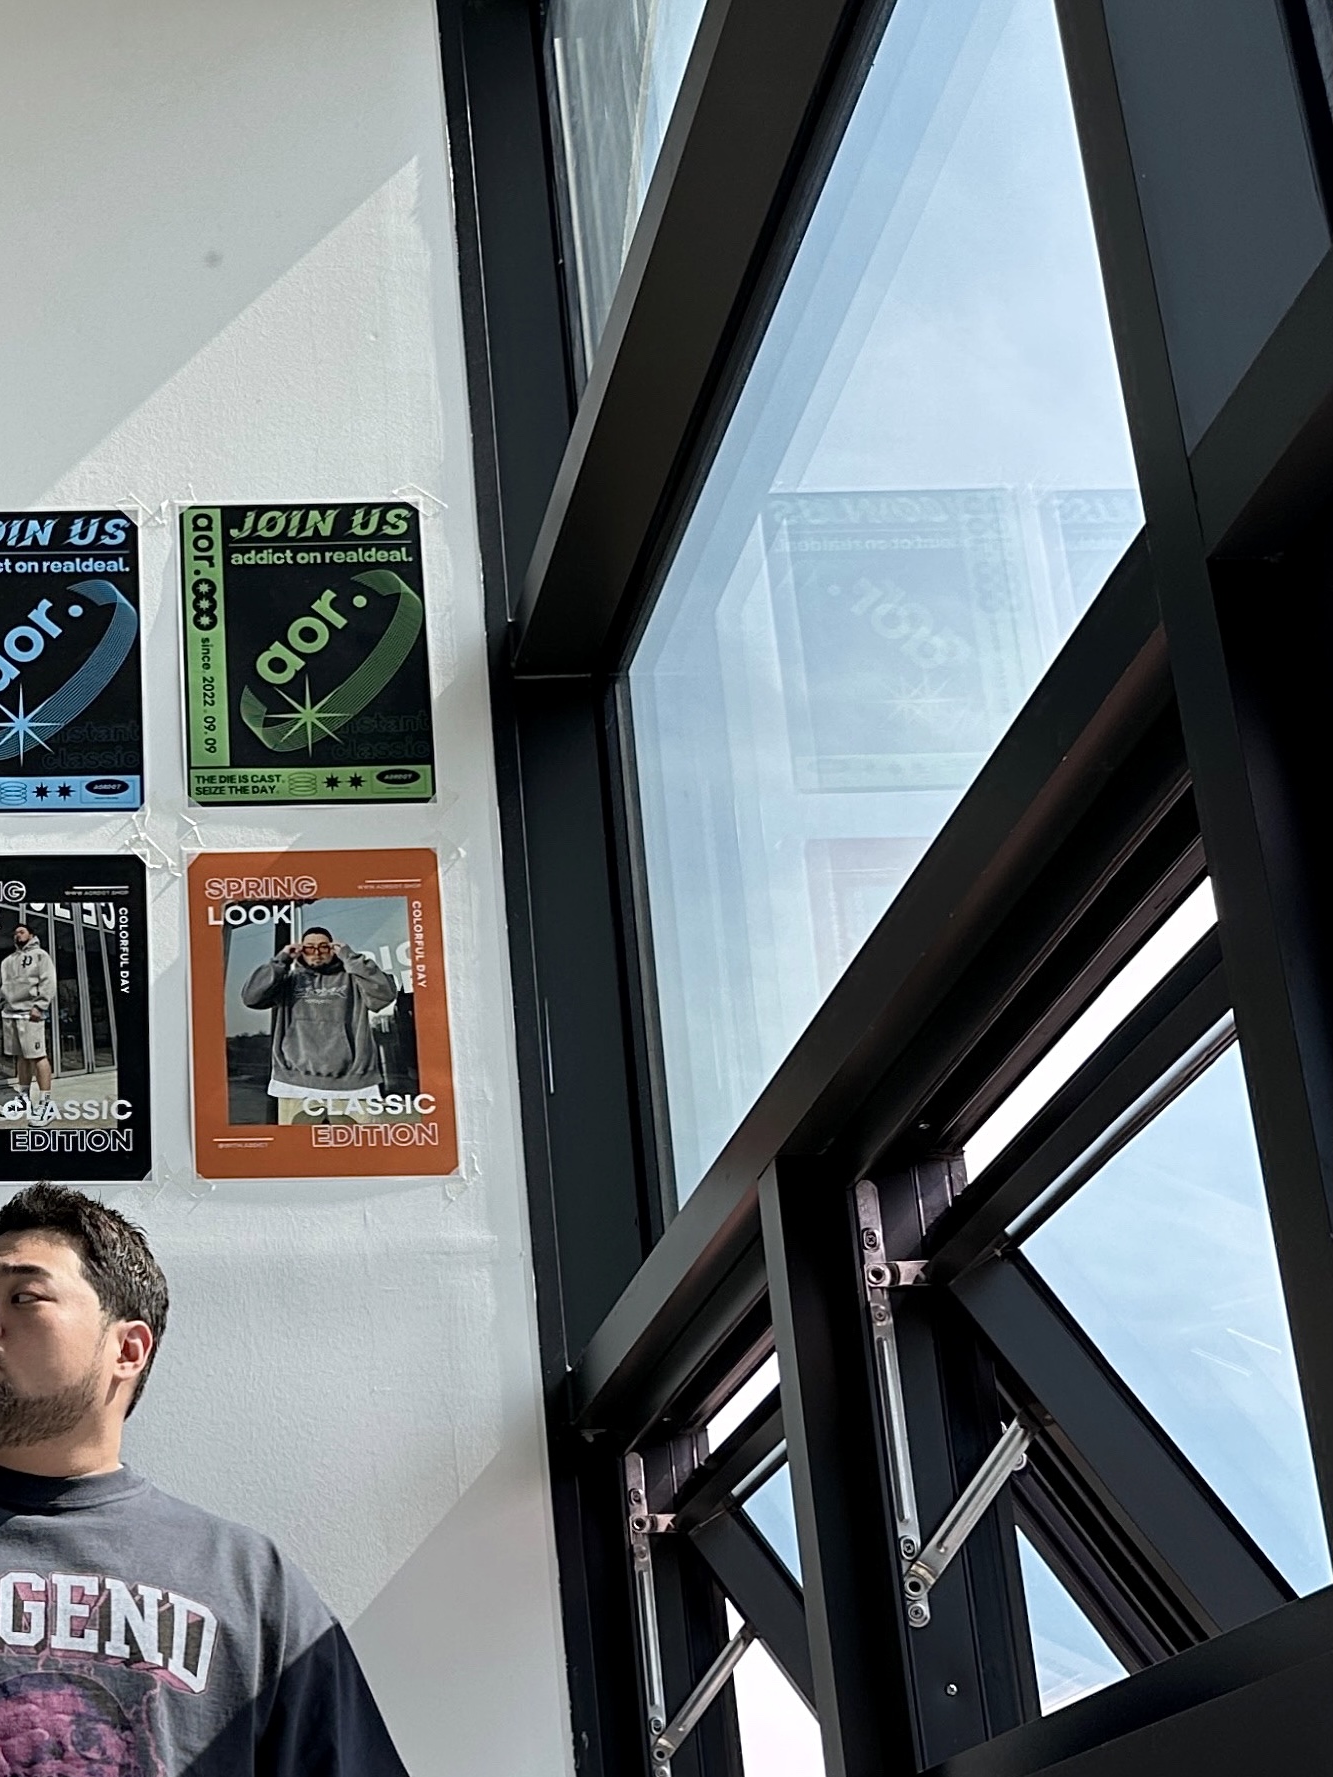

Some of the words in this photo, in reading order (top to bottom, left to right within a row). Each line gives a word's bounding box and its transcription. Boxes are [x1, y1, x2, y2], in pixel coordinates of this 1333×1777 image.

[62, 517, 130, 546] US
[229, 508, 341, 540] JOIN
[343, 507, 413, 537] US
[191, 513, 214, 577] aor.
[230, 549, 293, 565] addict
[296, 551, 321, 564] on
[324, 547, 413, 563] realdeal.
[14, 561, 40, 573] on
[42, 557, 129, 573] realdeal.
[256, 588, 367, 685] aor.
[205, 737, 217, 754] 09
[194, 775, 217, 784] THE
[219, 775, 237, 783] DIE
[238, 774, 249, 783] IS
[195, 786, 226, 795] SEIZE
[228, 786, 250, 794] THE
[205, 875, 318, 900] SPRING
[208, 904, 293, 926] LOOK
[118, 906, 129, 966] COLORFUL
[412, 901, 425, 962] COLORFUL
[119, 970, 130, 994] DAY
[416, 964, 428, 989] DAY
[2, 1099, 133, 1121] CLASSIC
[302, 1092, 436, 1116] CLASSIC
[10, 1129, 133, 1152] EDITION
[311, 1122, 439, 1147] EDITION
